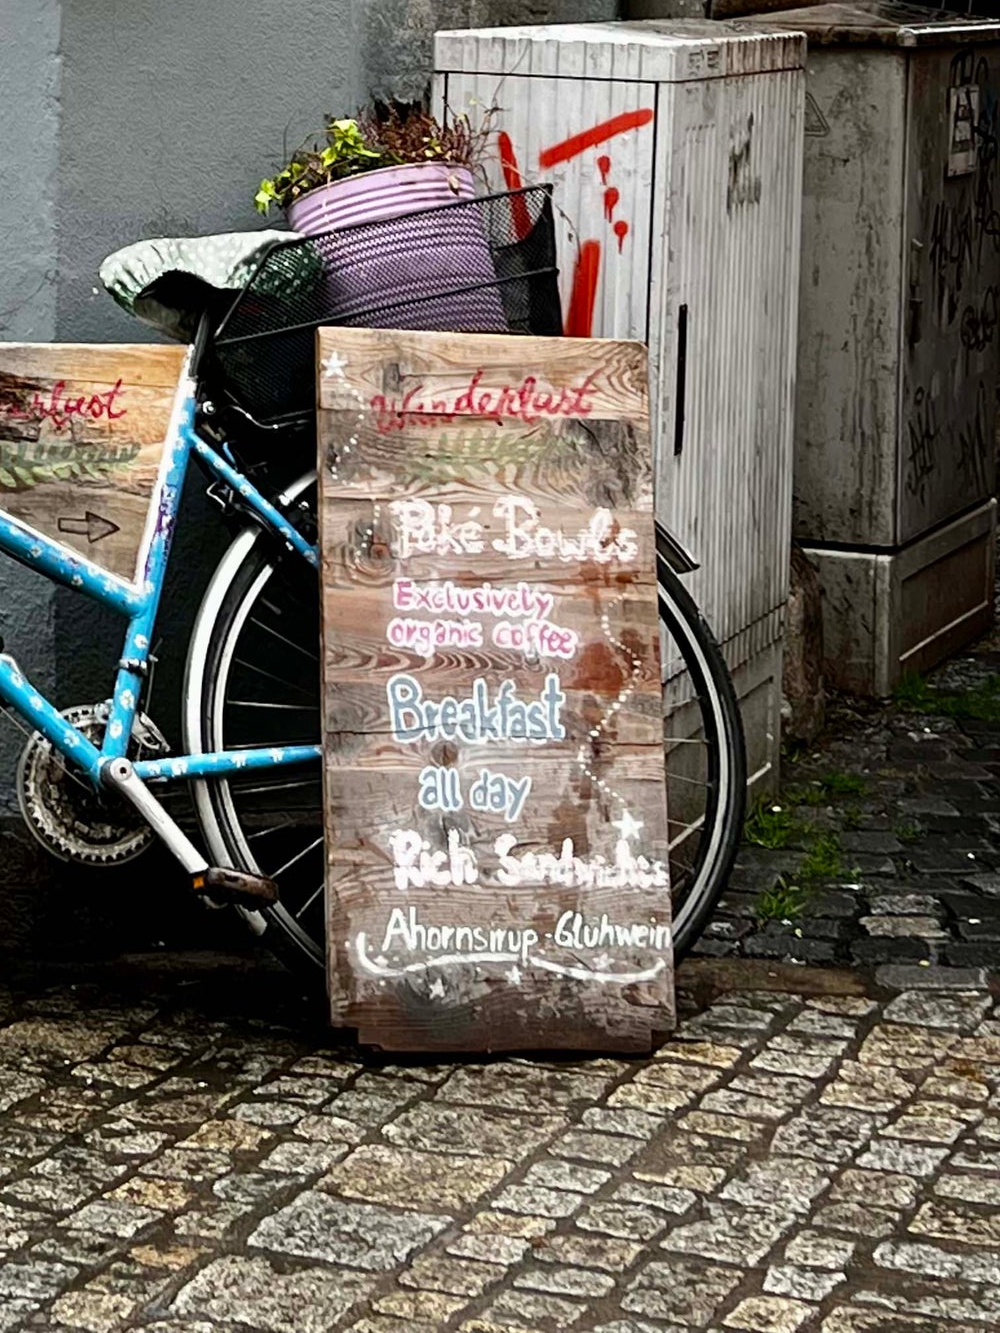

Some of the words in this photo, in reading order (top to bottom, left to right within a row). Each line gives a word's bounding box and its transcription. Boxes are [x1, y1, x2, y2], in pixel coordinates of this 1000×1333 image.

[393, 577, 553, 620] Exclusively
[387, 617, 483, 657] organic
[493, 618, 579, 659] coffee
[387, 673, 565, 744] Breakfast
[419, 766, 460, 811] all
[470, 769, 532, 821] day
